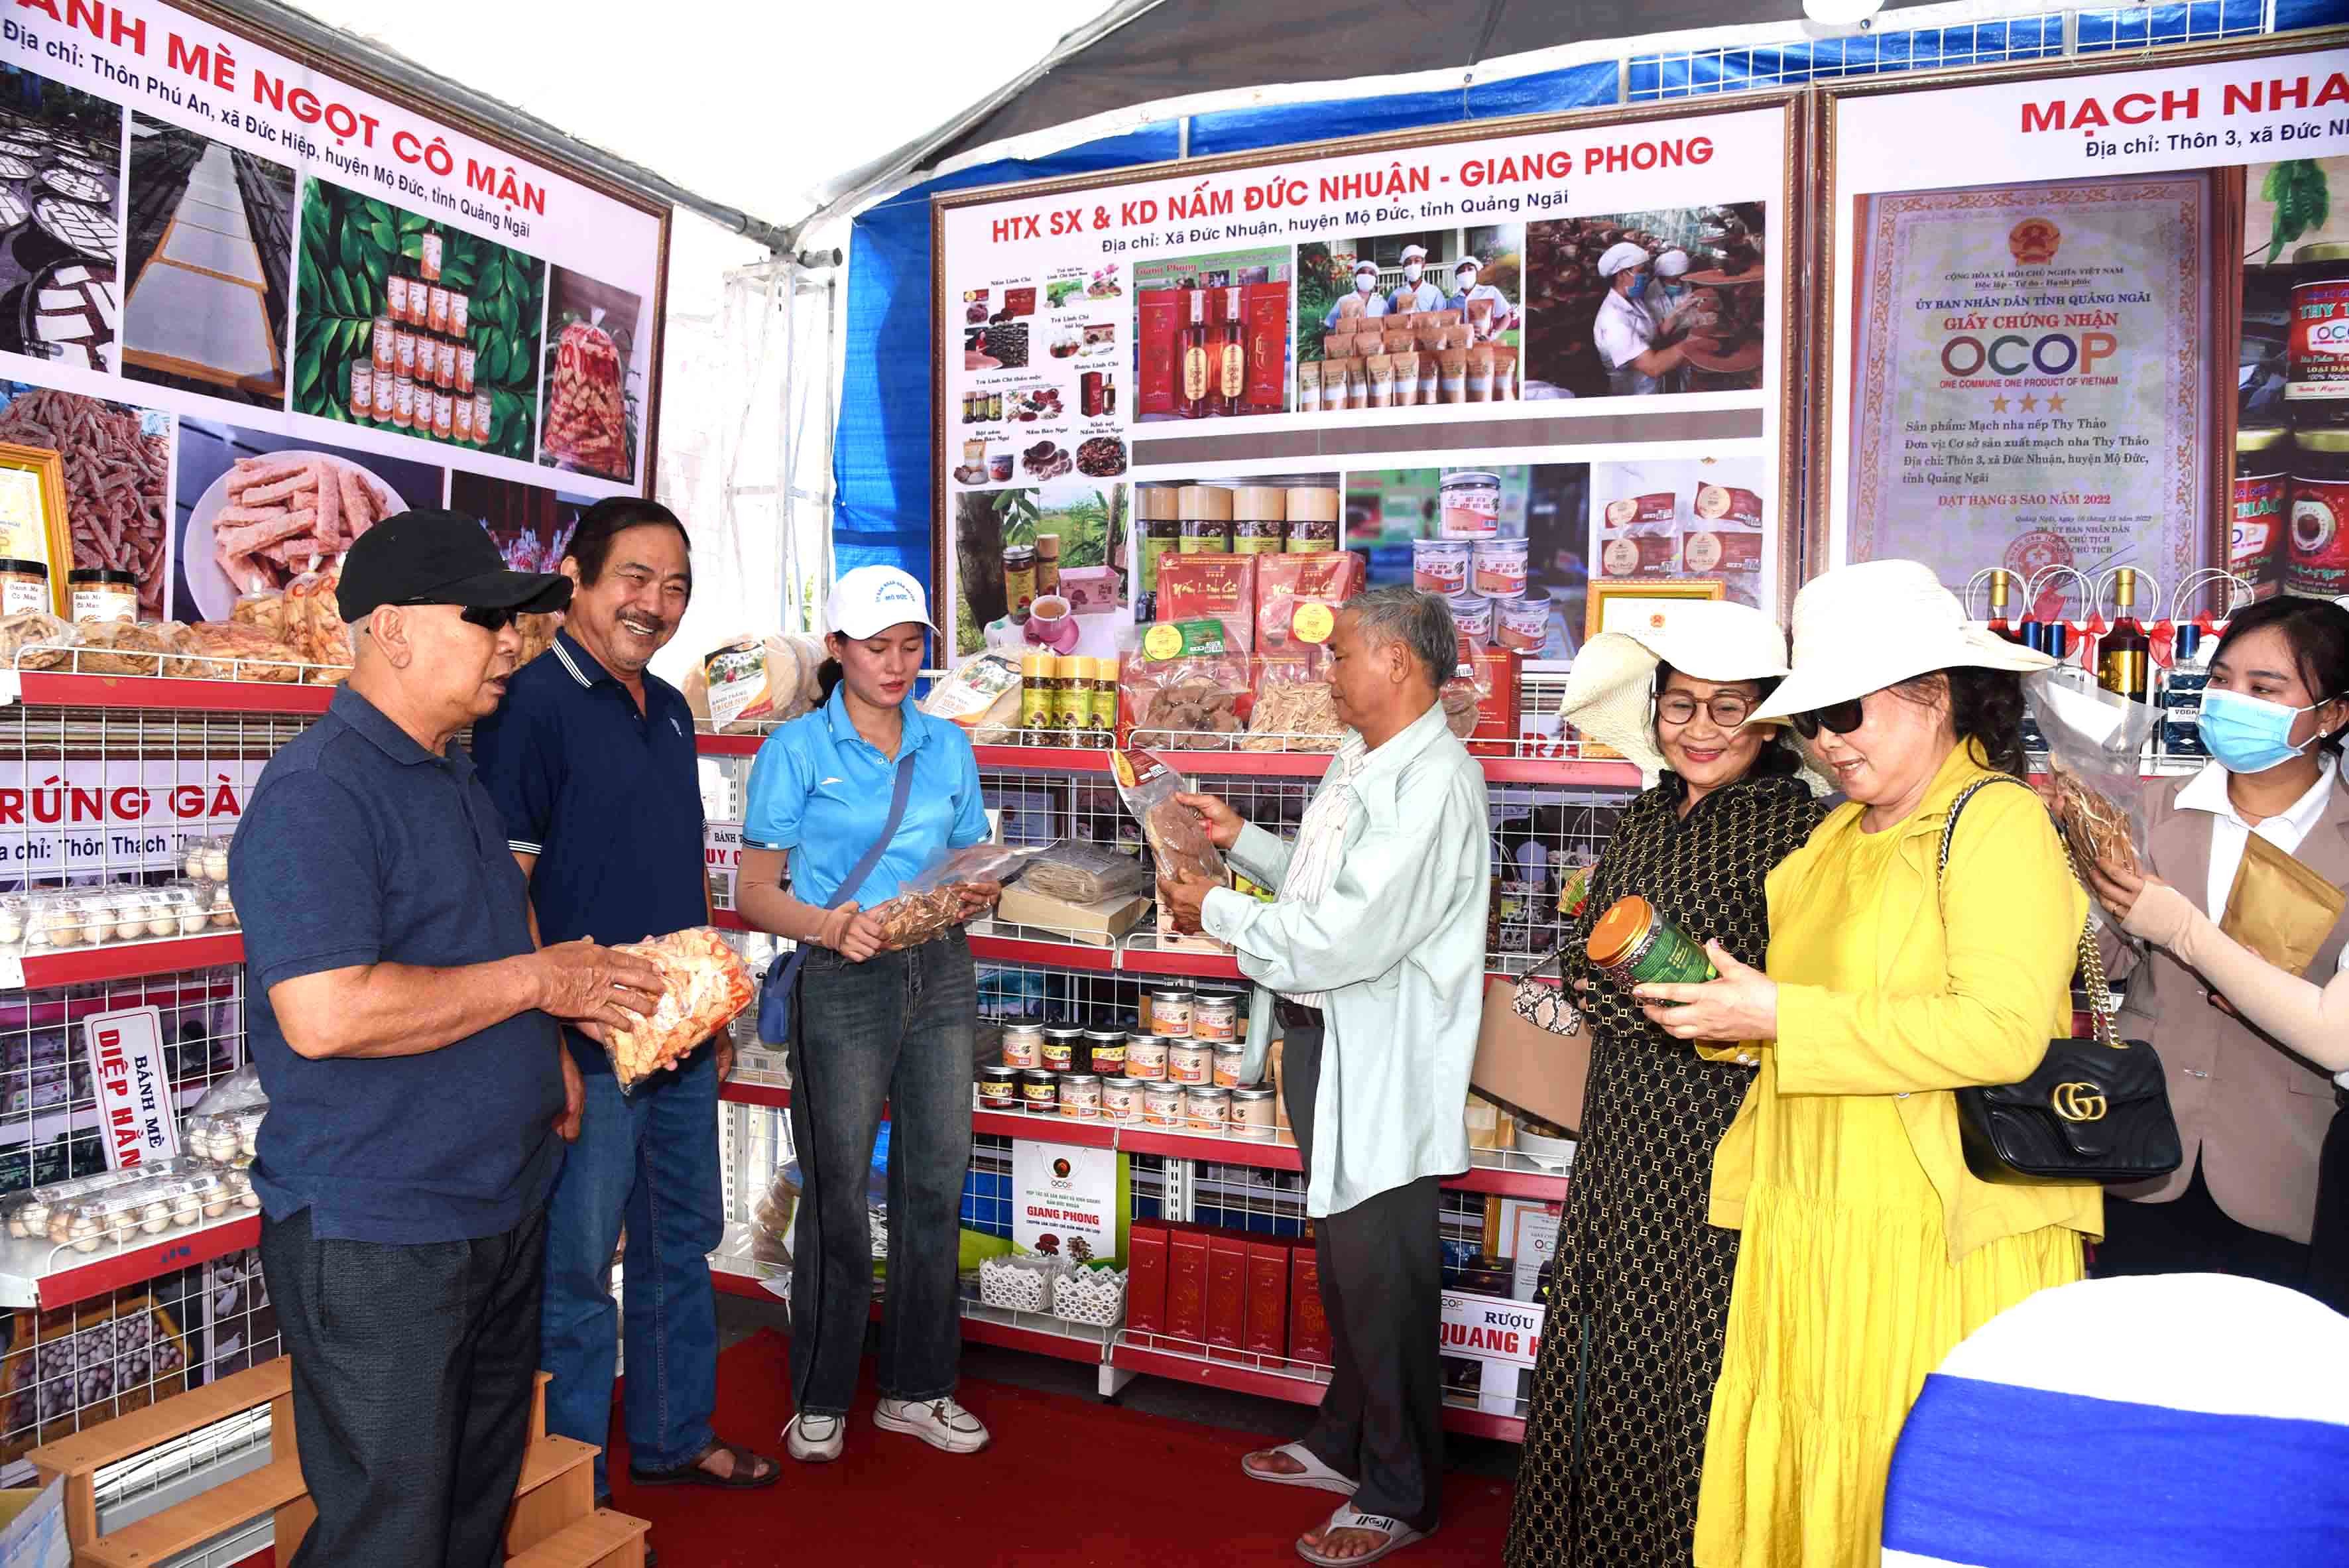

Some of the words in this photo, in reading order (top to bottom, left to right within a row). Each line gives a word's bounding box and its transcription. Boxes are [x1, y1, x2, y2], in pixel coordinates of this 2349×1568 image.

[2021, 88, 2200, 137] MẠCH
[2223, 72, 2349, 116] NHA
[3, 19, 38, 50] Địa
[46, 40, 84, 68] chỉ:
[91, 54, 139, 91] Thôn
[147, 76, 182, 106] Phú
[187, 93, 215, 122] An,
[221, 109, 239, 129] xã
[245, 115, 277, 142] Đức
[282, 131, 320, 161] Hiệp,
[325, 145, 369, 177] huyện
[374, 165, 395, 187] Mộ
[398, 175, 428, 201] Đức,
[432, 185, 457, 211] tỉnh
[460, 198, 500, 230] Quảng
[504, 213, 530, 238] Ngãi
[168, 32, 236, 93] MÈ
[254, 69, 380, 149] NGỌT
[392, 130, 453, 176] CÔ
[466, 158, 546, 216] MẬN
[2085, 141, 2118, 159] Địa
[2123, 135, 2160, 154] chỉ:
[2167, 131, 2218, 152] Thôn
[2225, 129, 2242, 149] 3,
[2249, 126, 2273, 144] xã
[2281, 117, 2322, 141] Đức
[993, 214, 1041, 243] HTX
[1050, 208, 1083, 236] SX
[1093, 206, 1111, 230] &
[1121, 200, 1158, 227] KD
[1168, 180, 1233, 221] NẤM
[1244, 176, 1309, 210] ĐỨC
[1319, 162, 1430, 203] NHUẬN
[1459, 151, 1573, 188] GIANG
[1585, 136, 1715, 175] PHONG
[1103, 237, 1127, 254] Địa
[1132, 232, 1160, 249] chỉ:
[1165, 229, 1185, 246] Xã
[1189, 225, 1221, 243] Đức
[1225, 220, 1283, 239] Nhuận,
[1289, 213, 1339, 235] huyện
[1345, 209, 1372, 226] Mộ
[1376, 203, 1415, 223] Đức,
[1420, 200, 1455, 217] tỉnh
[1461, 195, 1521, 215] Quảng
[1527, 190, 1569, 210] Ngãi
[1935, 299, 1960, 309] BAN
[1964, 296, 2000, 308] NHÂN
[2004, 296, 2029, 306] DÂN
[2033, 293, 2065, 306] TỈNH
[2069, 292, 2114, 305] QUẢNG
[2118, 292, 2151, 303] NGÃI
[1944, 310, 1990, 330] GIẤY
[1993, 309, 2060, 330] CHỨNG
[2065, 310, 2119, 330] NHẬN
[2317, 326, 2349, 339] OC
[1941, 333, 2118, 377] OCOP
[1940, 380, 1957, 390] ONE
[1958, 379, 2002, 389] COMMUNE
[2004, 378, 2023, 388] ONE
[2024, 377, 2065, 387] PRODUCT
[2067, 377, 2078, 387] OF
[2080, 376, 2118, 386] VIETNAM
[1905, 420, 1927, 431] Sản
[1930, 418, 1965, 433] phẩm:
[1968, 420, 1999, 432] Mạch
[2003, 420, 2024, 430] nha
[2027, 418, 2048, 431] nếp
[2051, 418, 2074, 431] Thy
[2077, 417, 2106, 429] Thảo
[1949, 438, 1964, 448] Cơ
[2004, 436, 2030, 448] xuất
[2033, 438, 2064, 449] mạch
[2068, 437, 2089, 446] nha
[2092, 436, 2115, 448] Thy
[2119, 435, 2149, 446] Thảo
[1946, 455, 1973, 465] Thôn
[2003, 454, 2023, 464] Đức
[2027, 453, 2065, 466] Nhuận,
[2068, 453, 2101, 465] huyện
[2104, 453, 2121, 465] Mộ
[1927, 472, 1962, 485] Quảng
[2010, 495, 2018, 505] 3
[2019, 494, 2046, 505] SAO
[2049, 492, 2080, 505] NĂM
[2084, 495, 2112, 505] 2022
[168, 773, 241, 819] GÀ
[112, 835, 166, 858] Thạch
[715, 829, 736, 843] BÁNH
[97, 1029, 128, 1097] DIỆP
[134, 1055, 155, 1111] BÁNH
[145, 1116, 164, 1148] MÈ
[1027, 1206, 1060, 1221] GIANG
[1063, 1210, 1099, 1225] PHONG
[1484, 1311, 1534, 1330] RƯỢU
